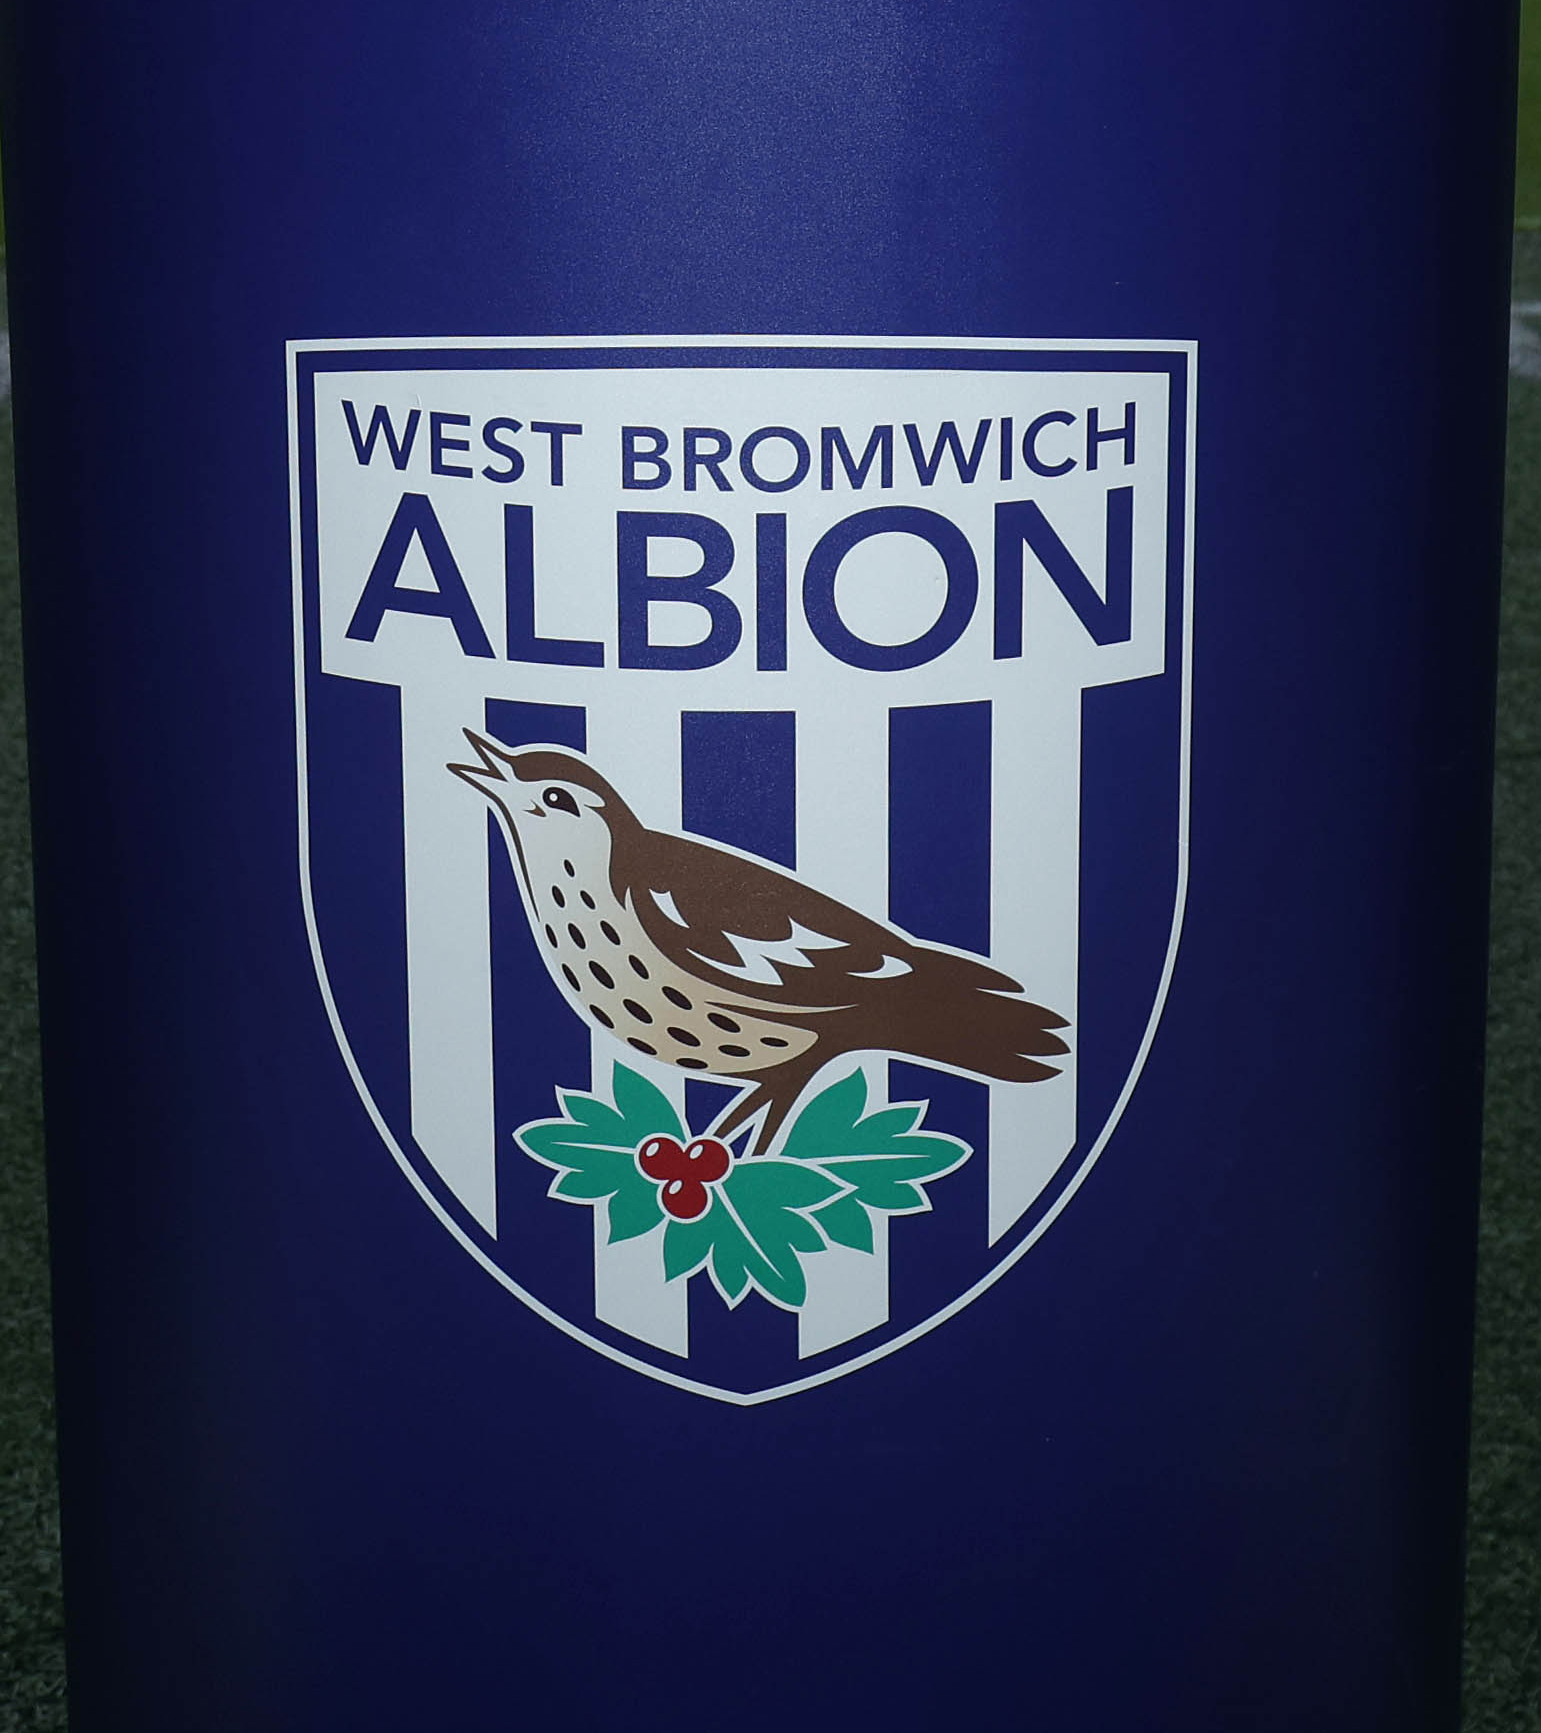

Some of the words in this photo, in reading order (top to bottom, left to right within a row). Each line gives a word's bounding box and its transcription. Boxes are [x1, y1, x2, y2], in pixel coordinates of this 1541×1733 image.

[341, 399, 582, 487] WEST
[621, 402, 1136, 493] BROMWICH
[345, 486, 1134, 672] ALBION
